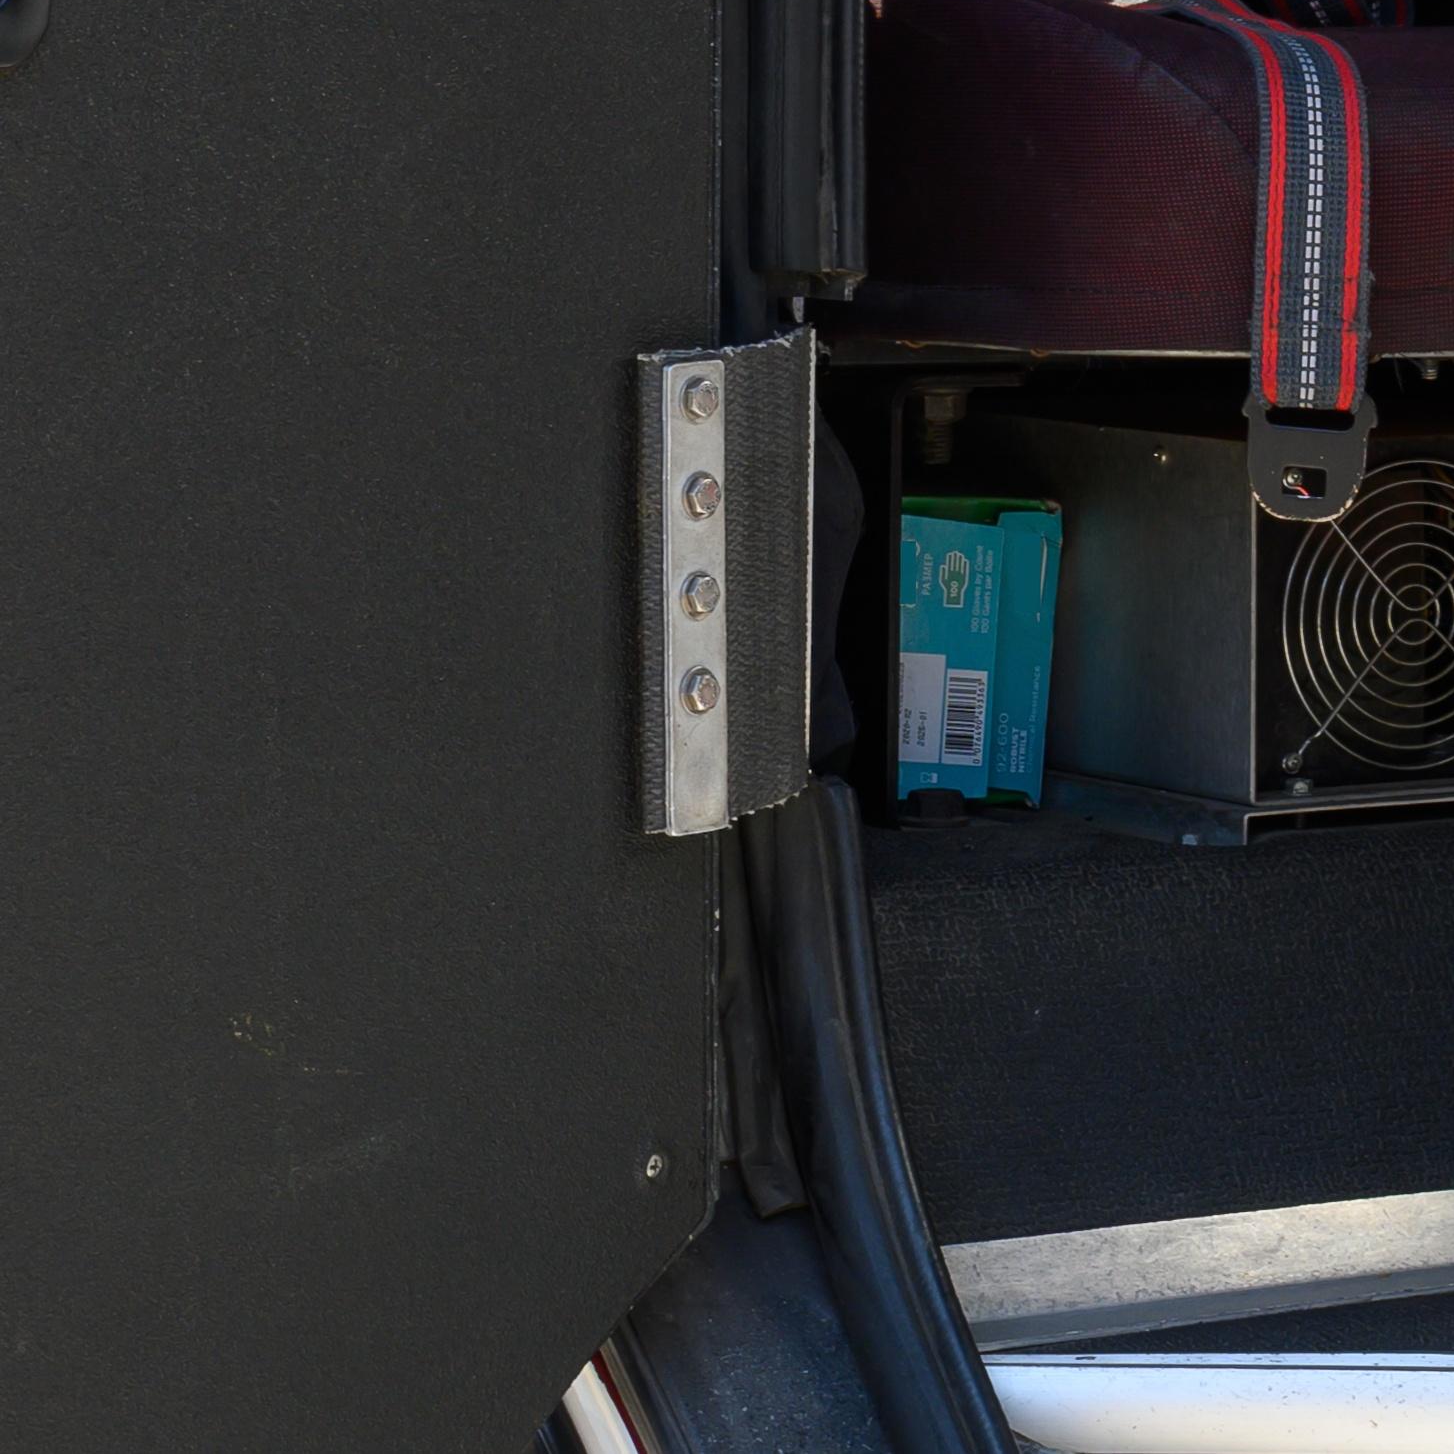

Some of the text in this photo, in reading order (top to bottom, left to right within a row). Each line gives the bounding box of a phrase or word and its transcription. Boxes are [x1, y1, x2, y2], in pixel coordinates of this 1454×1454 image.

[974, 545, 984, 571] Count
[950, 580, 959, 598] 100
[973, 573, 984, 585] by
[972, 587, 983, 616] Gloves
[1010, 727, 1019, 773] ROBUST
[1018, 729, 1028, 773] NITRILE
